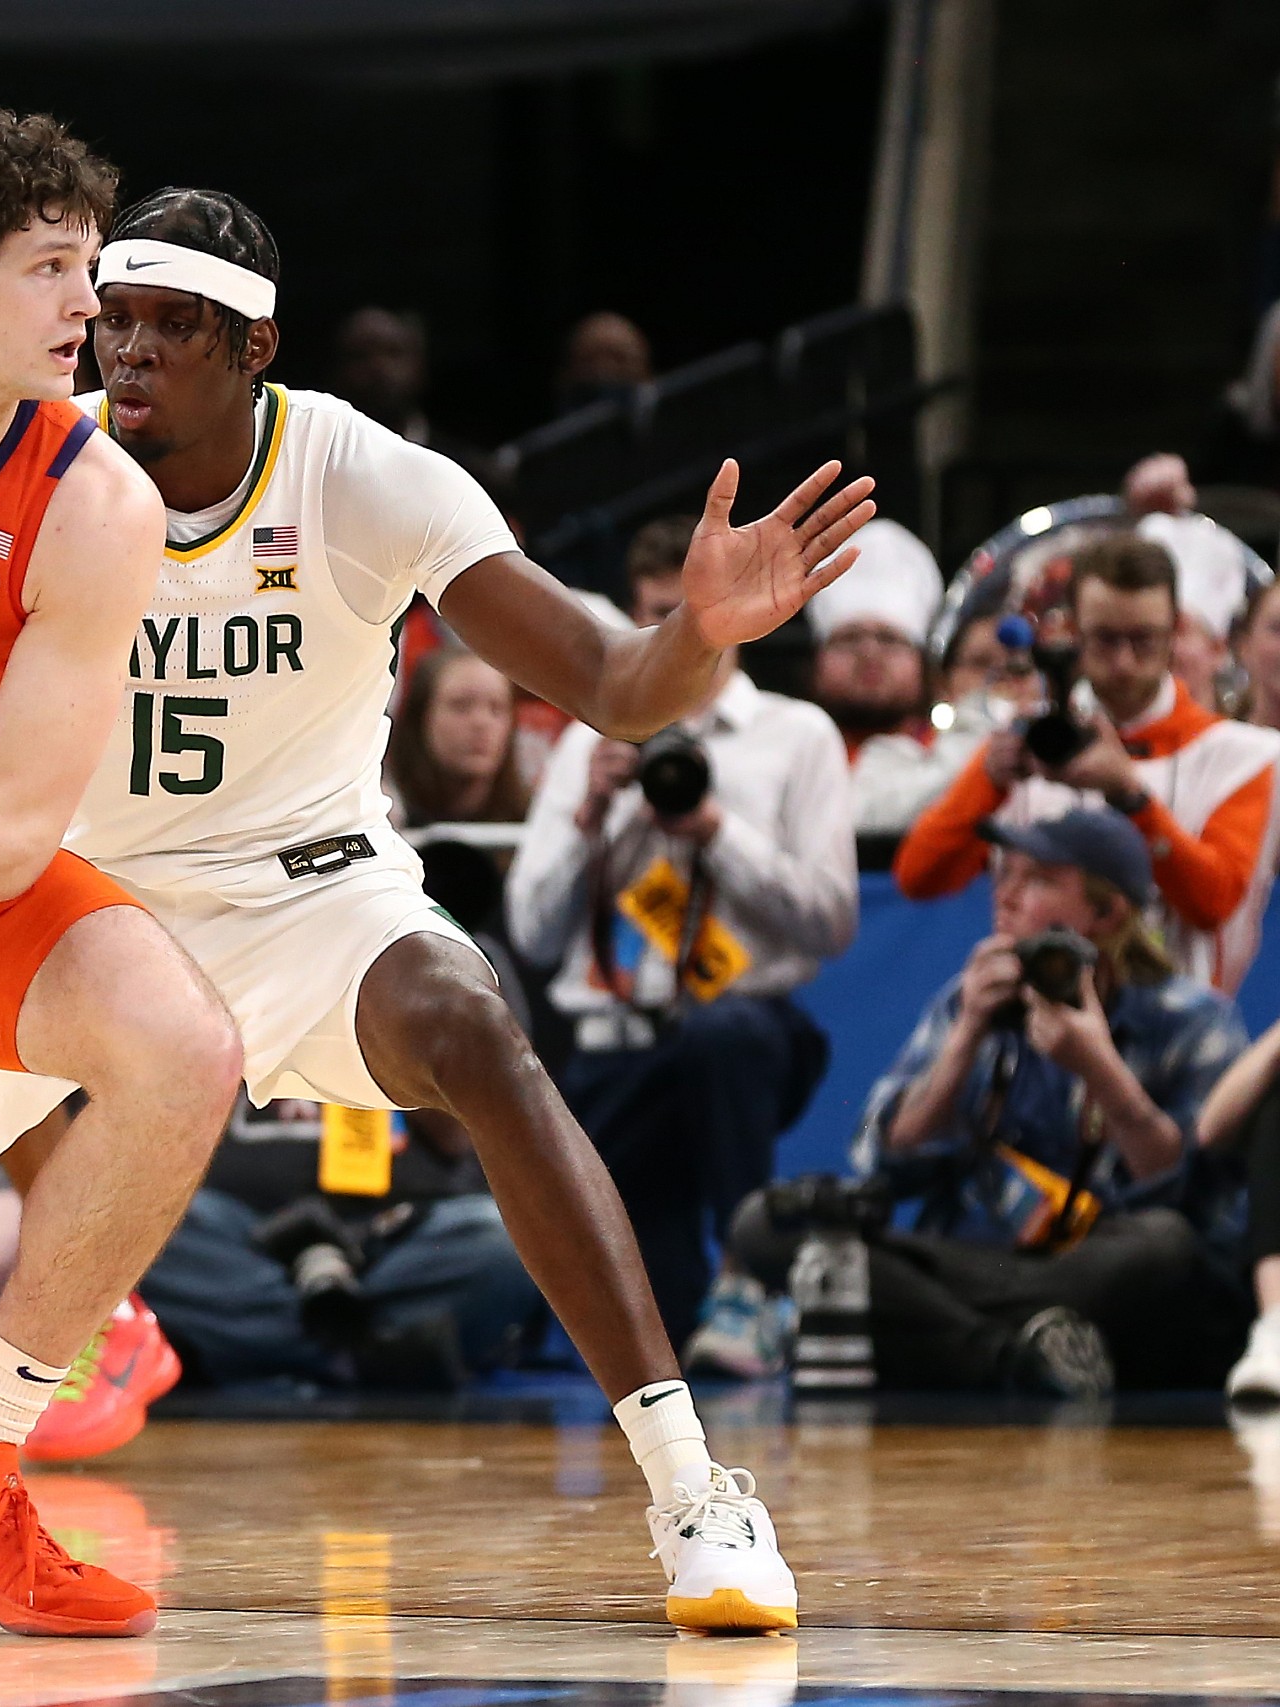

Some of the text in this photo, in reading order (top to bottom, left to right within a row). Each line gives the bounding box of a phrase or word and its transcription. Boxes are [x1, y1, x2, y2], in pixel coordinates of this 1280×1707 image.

[256, 567, 297, 590] XII
[129, 692, 229, 797] 15
[345, 841, 361, 852] 48
